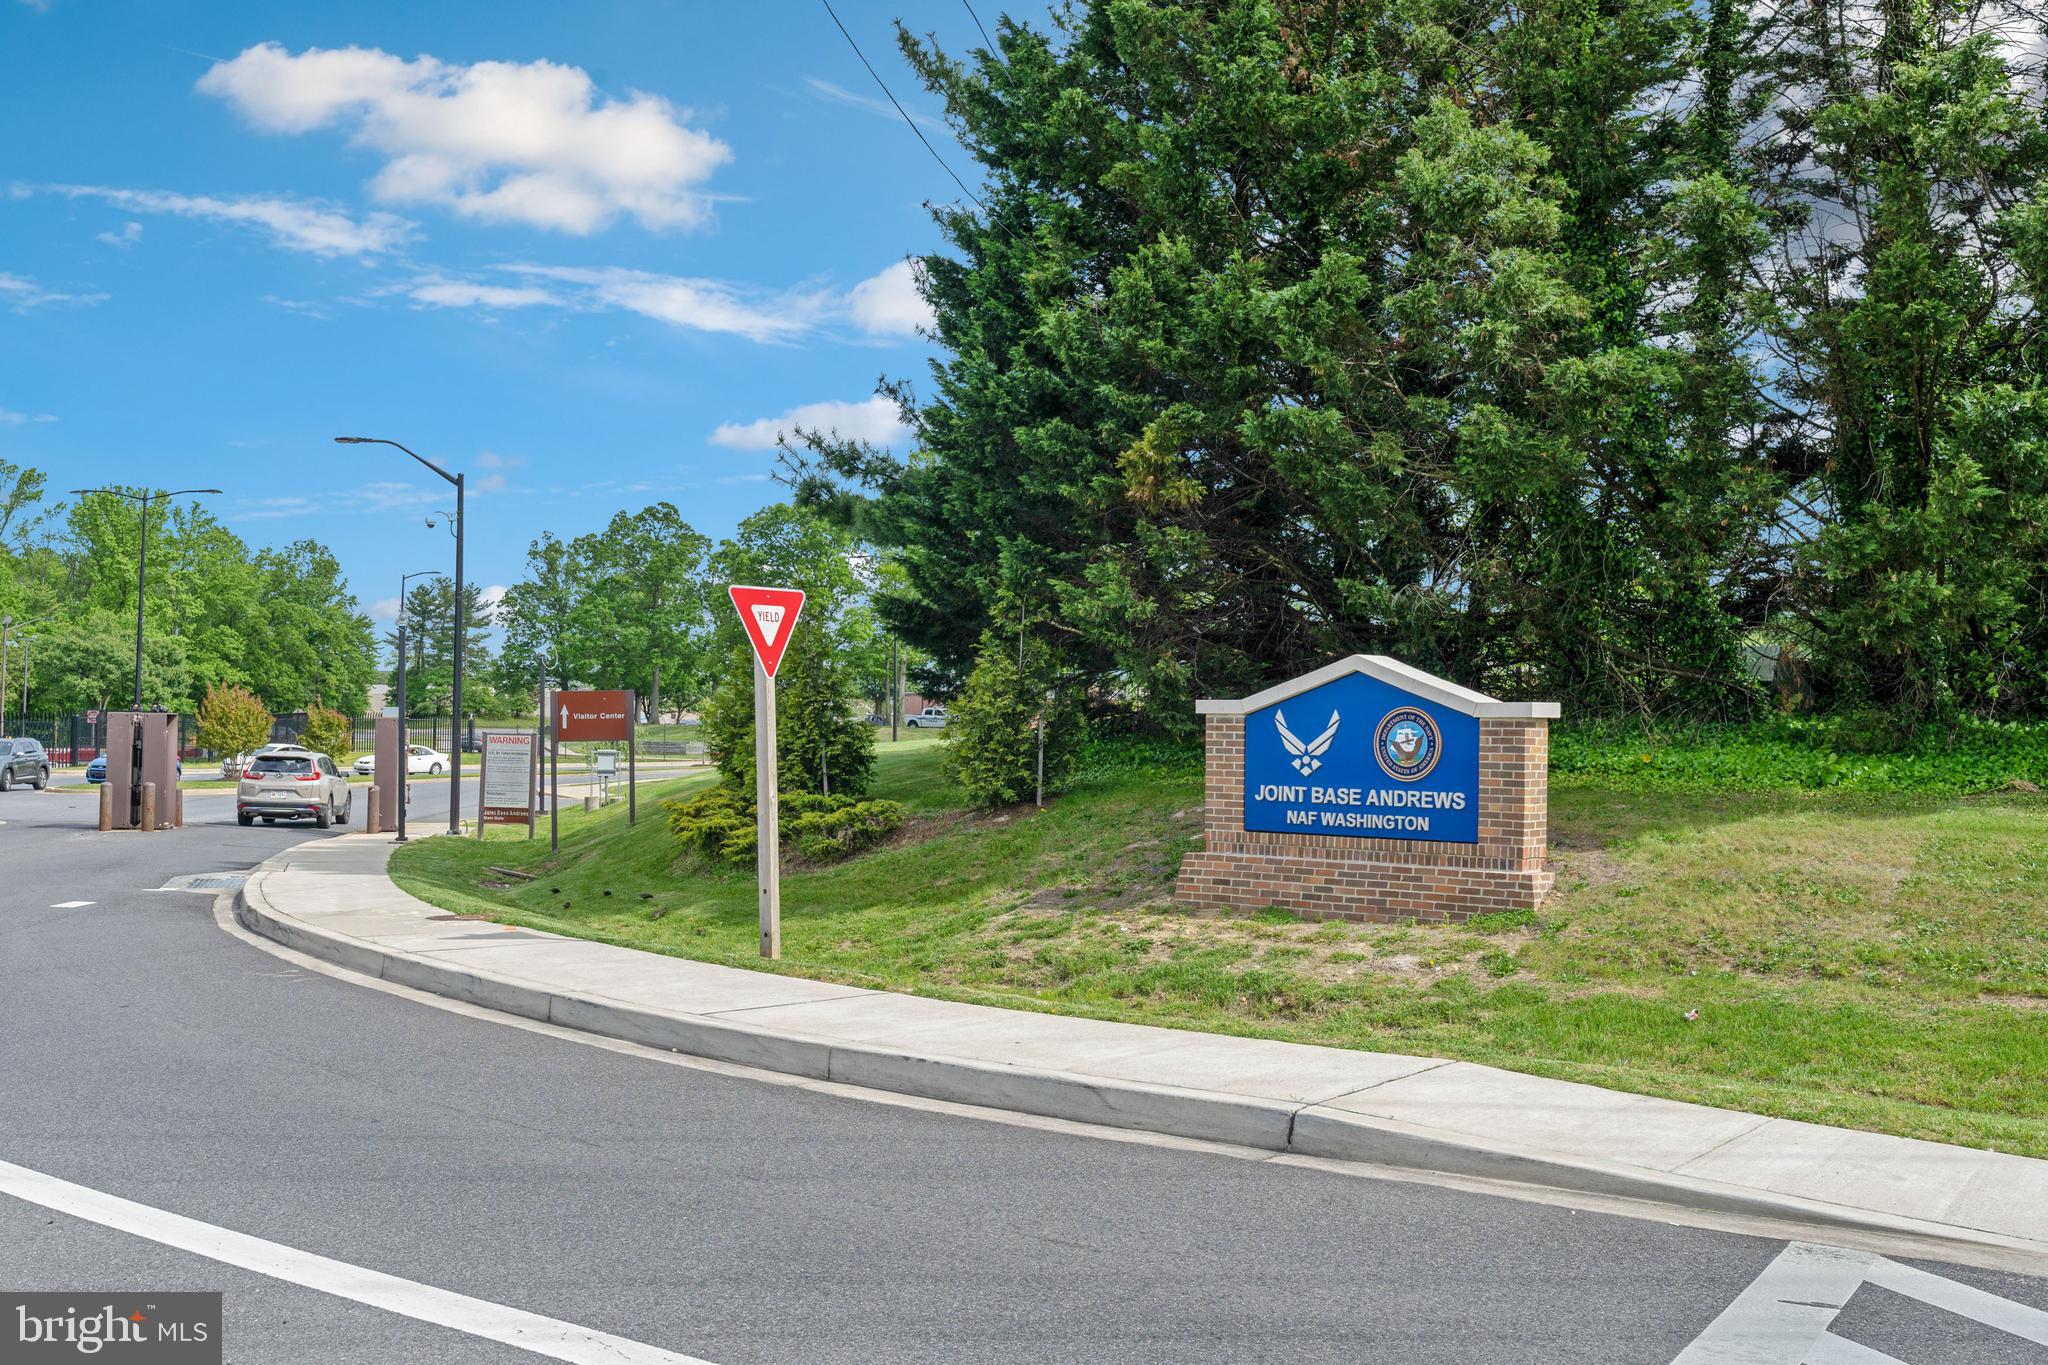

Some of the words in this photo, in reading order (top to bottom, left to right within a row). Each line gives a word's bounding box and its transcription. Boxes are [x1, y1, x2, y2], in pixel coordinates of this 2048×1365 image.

[757, 610, 780, 623] YIELD
[573, 712, 598, 720] Visitor
[1381, 714, 1407, 740] DEPARTMENT
[1416, 716, 1426, 727] THE
[1425, 726, 1434, 741] NAVY
[489, 736, 530, 745] WARNING
[1381, 746, 1393, 767] UNITED
[1392, 764, 1410, 774] STATES
[1418, 747, 1434, 769] AMERICA
[1254, 784, 1307, 802] JOINT
[1311, 786, 1362, 806] BASE
[1366, 789, 1466, 810] ANDREWS
[1286, 810, 1318, 825] NAF
[1321, 811, 1430, 832] WASHINGTON
